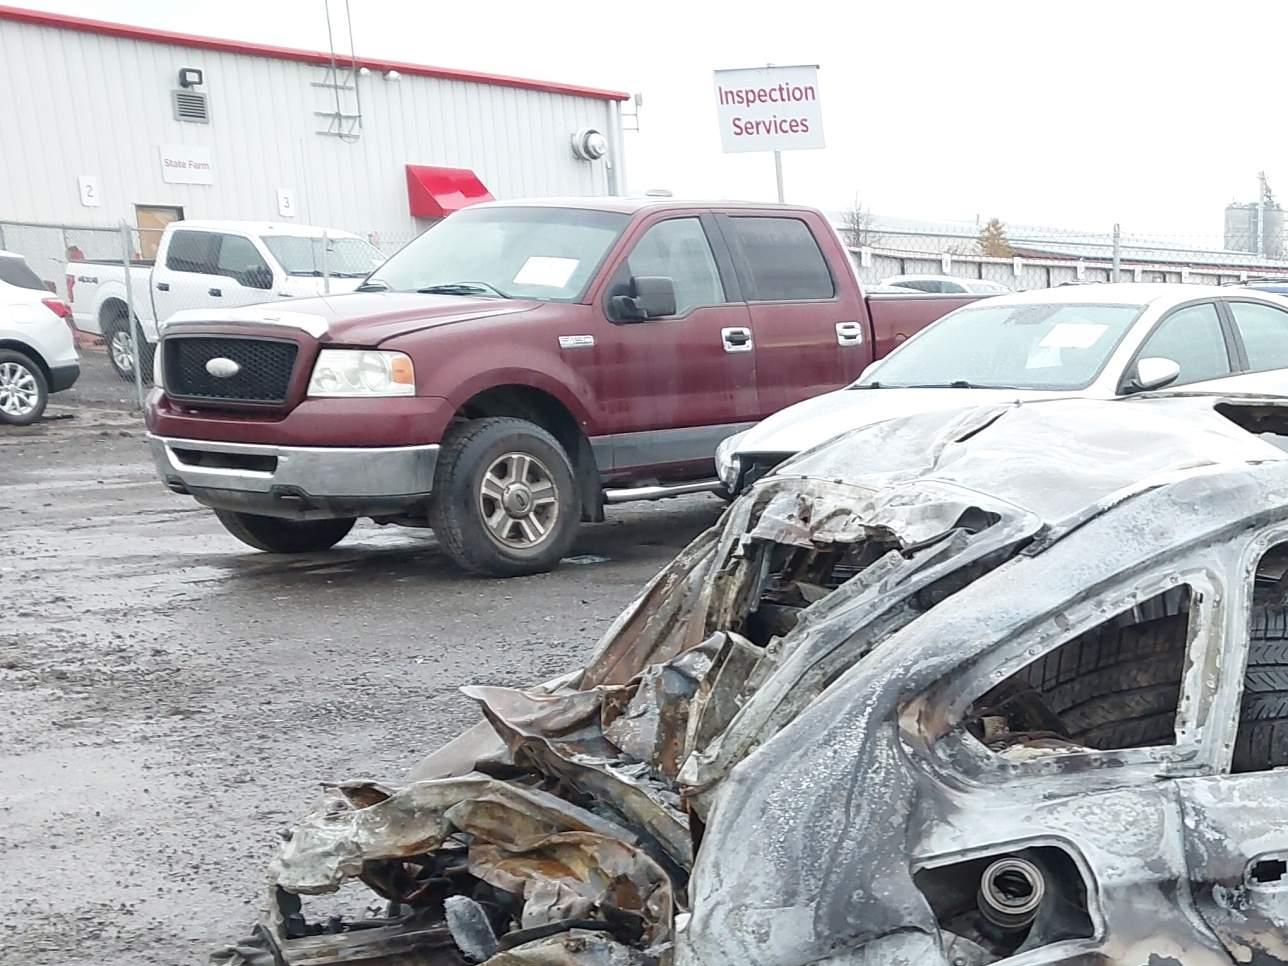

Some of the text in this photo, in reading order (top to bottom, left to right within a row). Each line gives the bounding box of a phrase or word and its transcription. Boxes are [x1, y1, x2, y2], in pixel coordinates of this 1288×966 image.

[718, 82, 816, 108] Inspection
[732, 114, 810, 136] Services
[163, 158, 210, 170] State Farm
[85, 184, 95, 198] 2
[283, 196, 290, 209] 3
